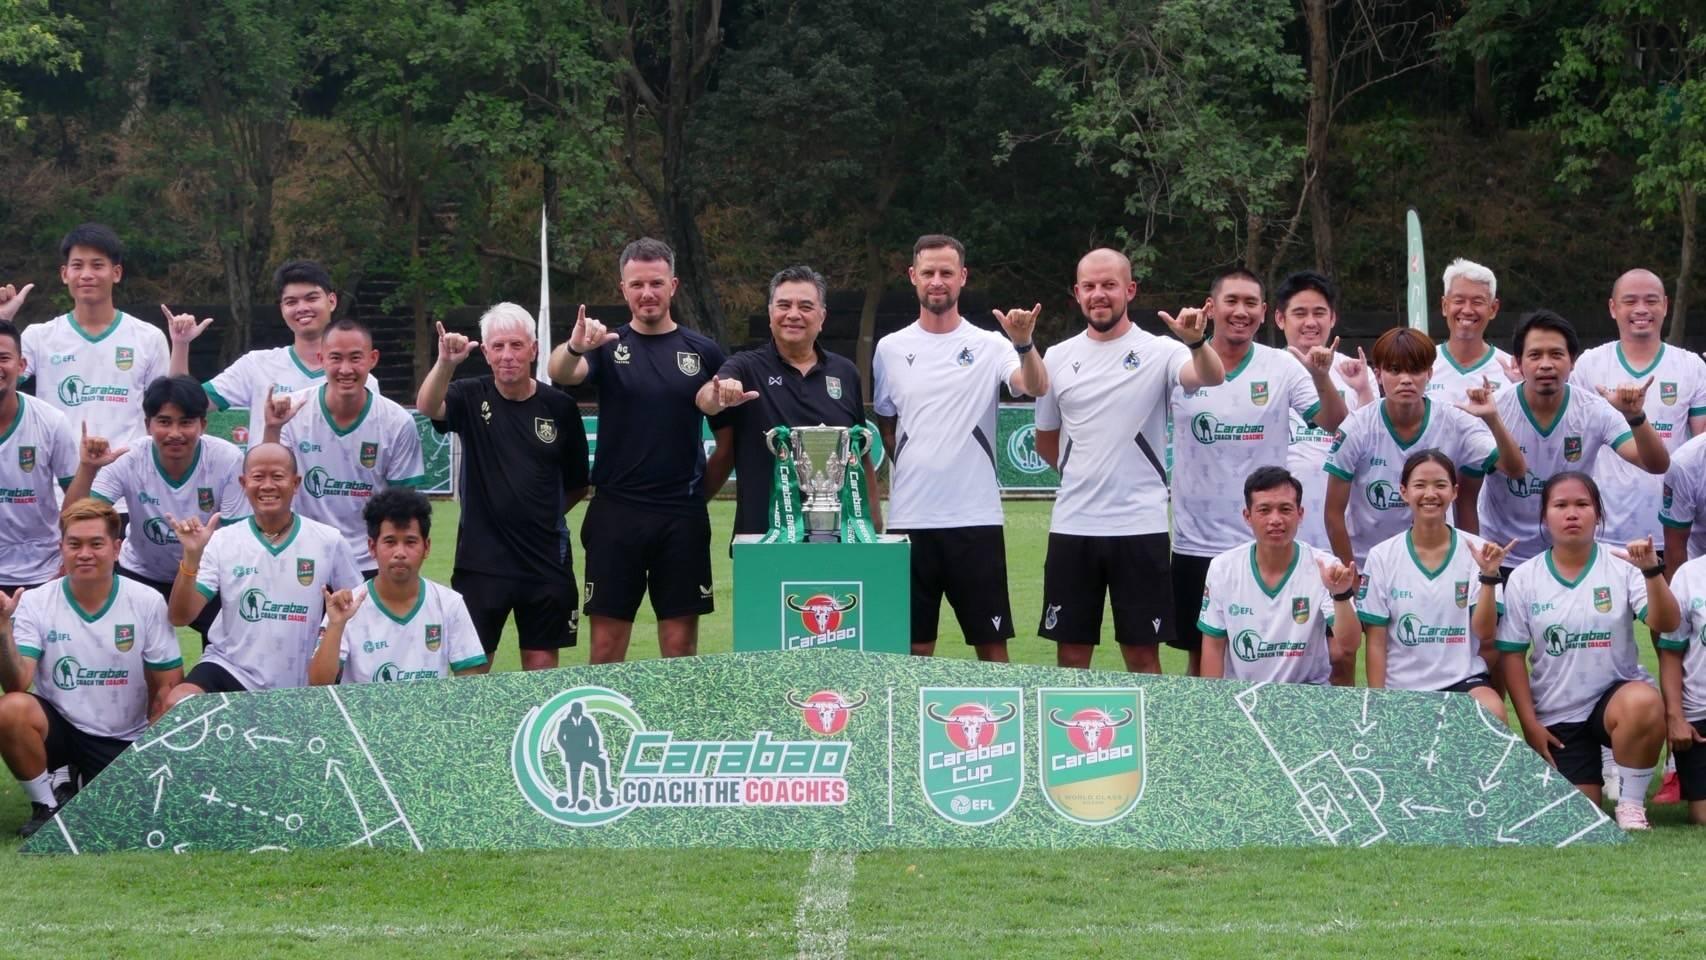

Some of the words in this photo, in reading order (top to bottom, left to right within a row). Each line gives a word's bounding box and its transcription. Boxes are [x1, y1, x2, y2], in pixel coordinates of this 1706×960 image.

[81, 385, 129, 396] Carabao
[1215, 422, 1265, 434] Carabao
[324, 478, 373, 490] Carabao
[780, 466, 793, 513] Carabao
[850, 471, 863, 517] Carabao
[245, 566, 259, 575] EFL
[262, 600, 308, 615] Carabao
[1240, 607, 1254, 616] EFL
[1419, 625, 1466, 636] Carabao
[789, 627, 856, 650] Carabao
[375, 640, 389, 650] EFL
[76, 668, 129, 679] Carabao
[396, 669, 439, 681] Carabao
[621, 731, 851, 777] Carabao
[928, 741, 1016, 770] Carabao
[1051, 744, 1133, 771] Carabao
[952, 763, 993, 784] Cup
[624, 780, 697, 803] COACH
[702, 780, 740, 803] THE
[745, 780, 846, 803] COACHES
[972, 799, 996, 811] EFL
